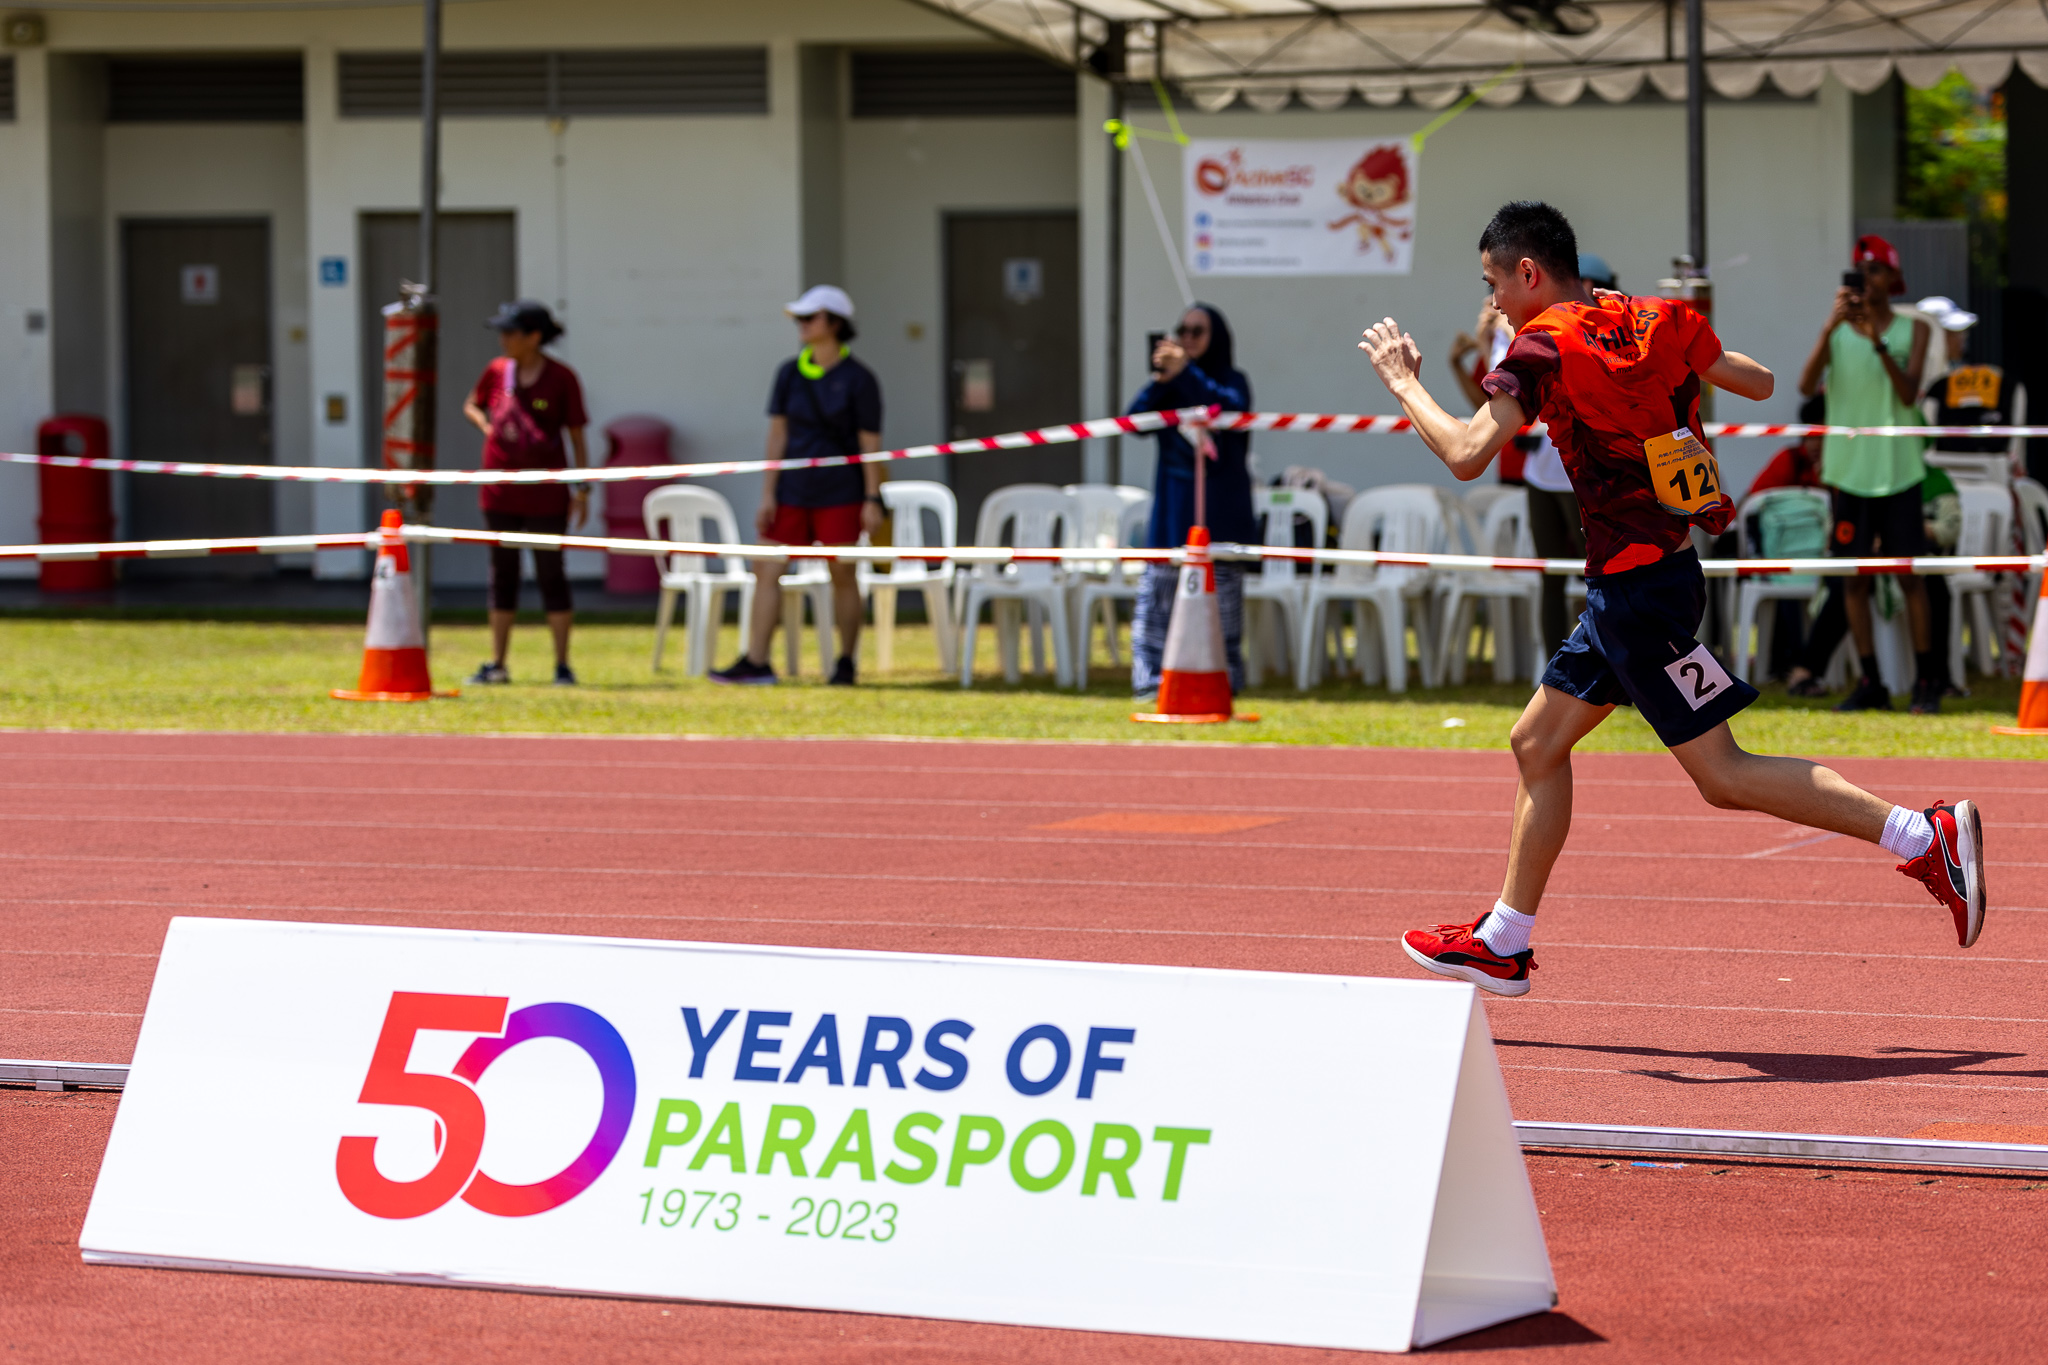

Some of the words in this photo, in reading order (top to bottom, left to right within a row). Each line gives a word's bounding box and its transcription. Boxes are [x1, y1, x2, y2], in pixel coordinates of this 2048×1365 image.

[1186, 570, 1199, 594] 6
[1680, 662, 1718, 700] 2
[681, 1006, 976, 1092] YEARS
[1004, 1023, 1137, 1101] OF
[335, 991, 638, 1220] 50
[643, 1097, 1212, 1202] PARASPORT
[641, 1188, 742, 1232] 1973
[785, 1196, 899, 1243] 2023
